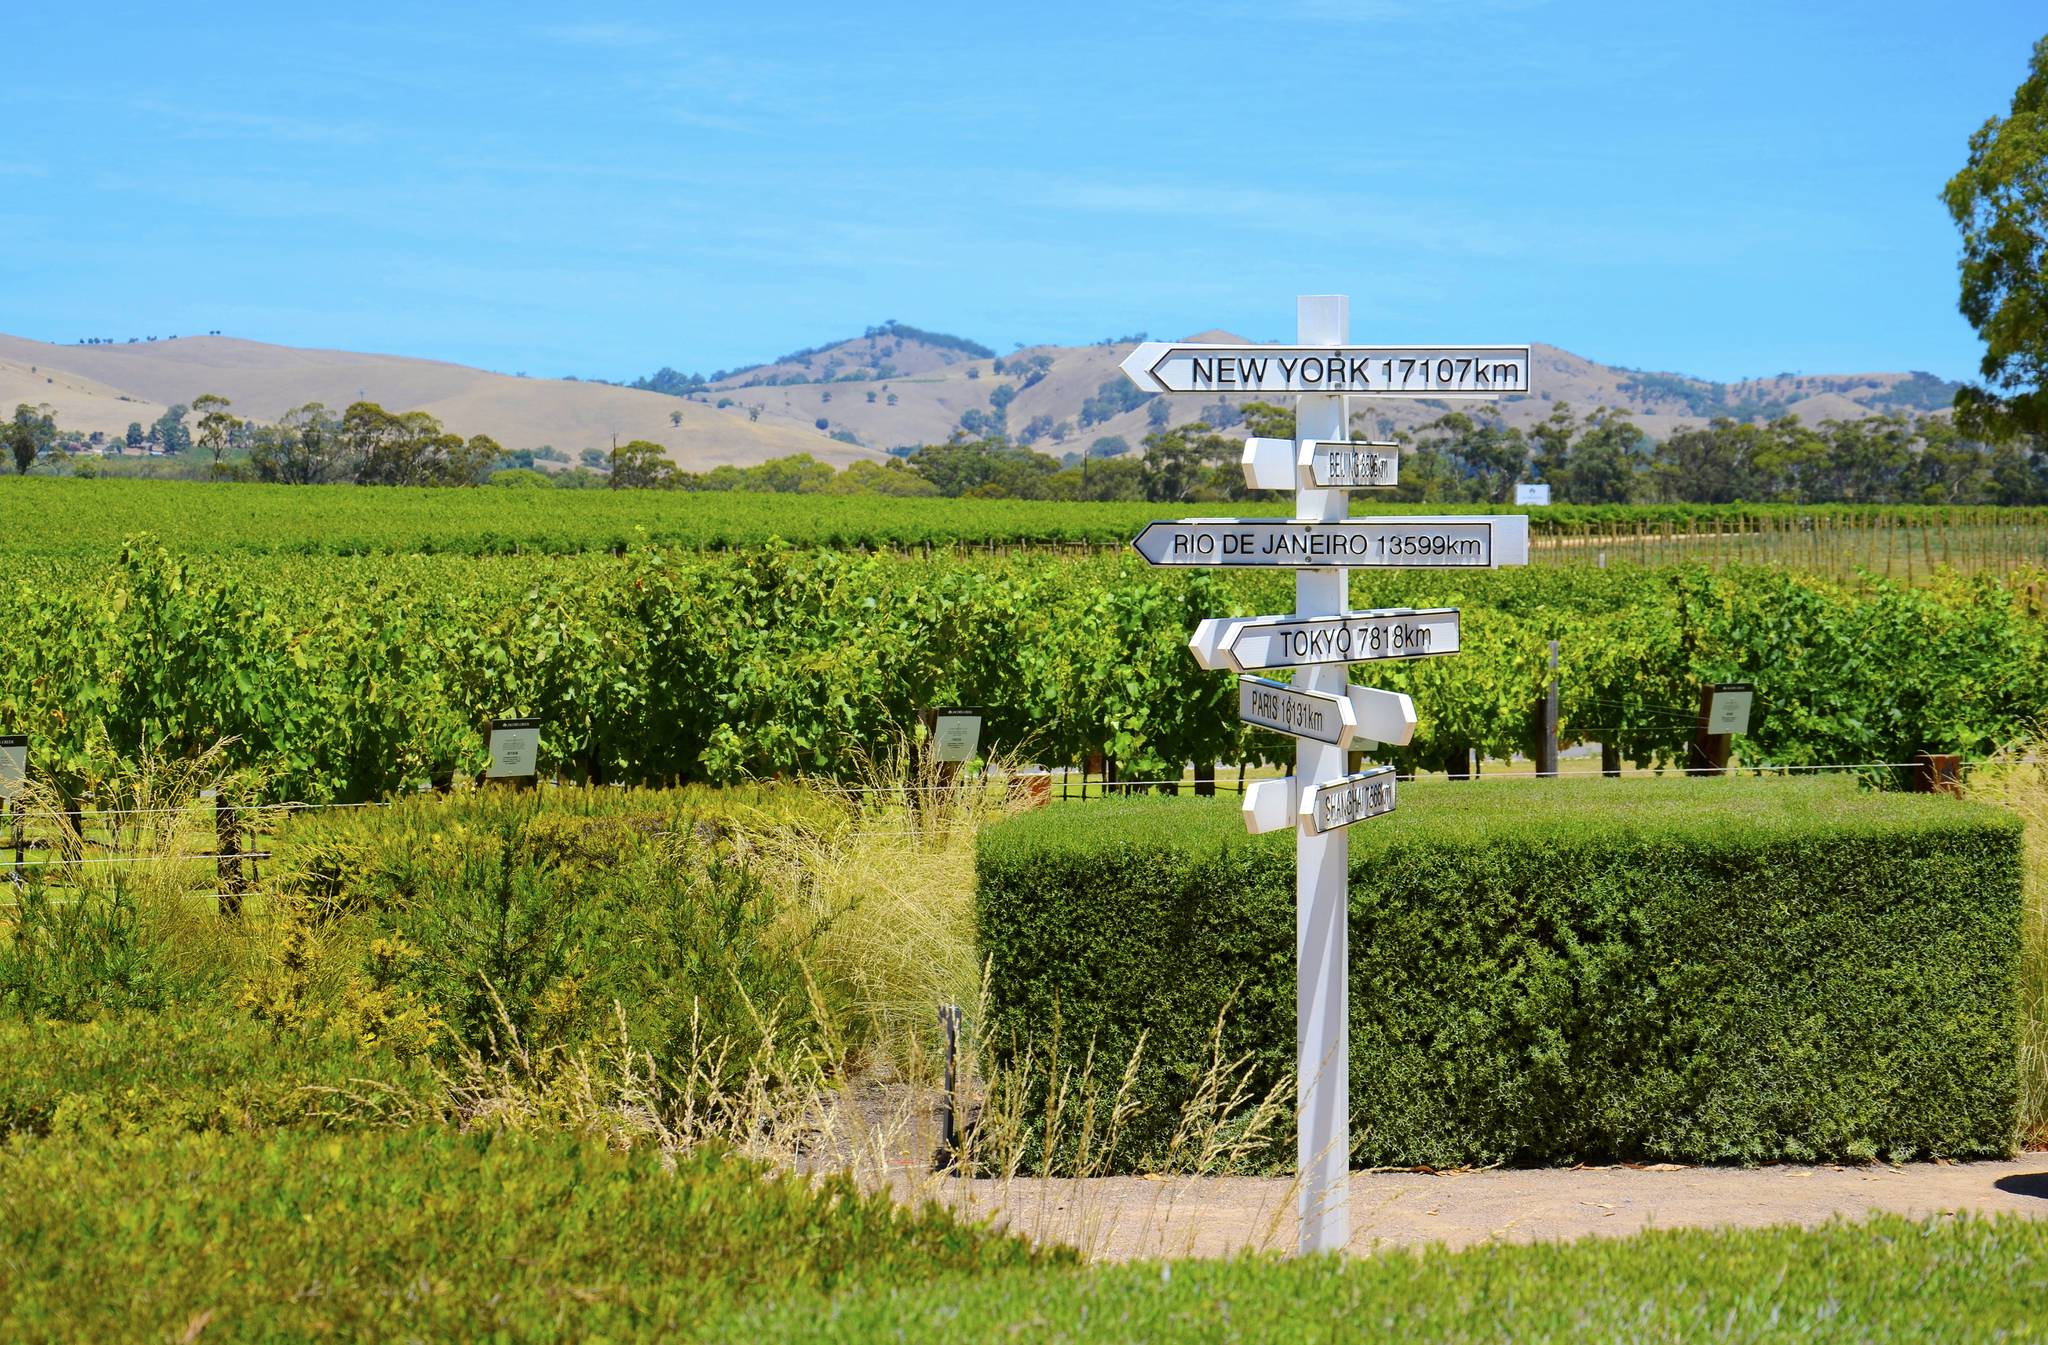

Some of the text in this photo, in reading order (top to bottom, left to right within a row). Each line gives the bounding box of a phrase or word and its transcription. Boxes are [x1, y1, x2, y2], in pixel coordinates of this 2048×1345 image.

[1192, 357, 1519, 384] NEW YORK 17107km
[1174, 534, 1481, 556] RIO DE JANEIRO 13599km
[1280, 624, 1432, 658] TOKYO 7818km
[1252, 690, 1323, 732] PARIS 16131km
[1325, 785, 1364, 821] SHANGHAI
